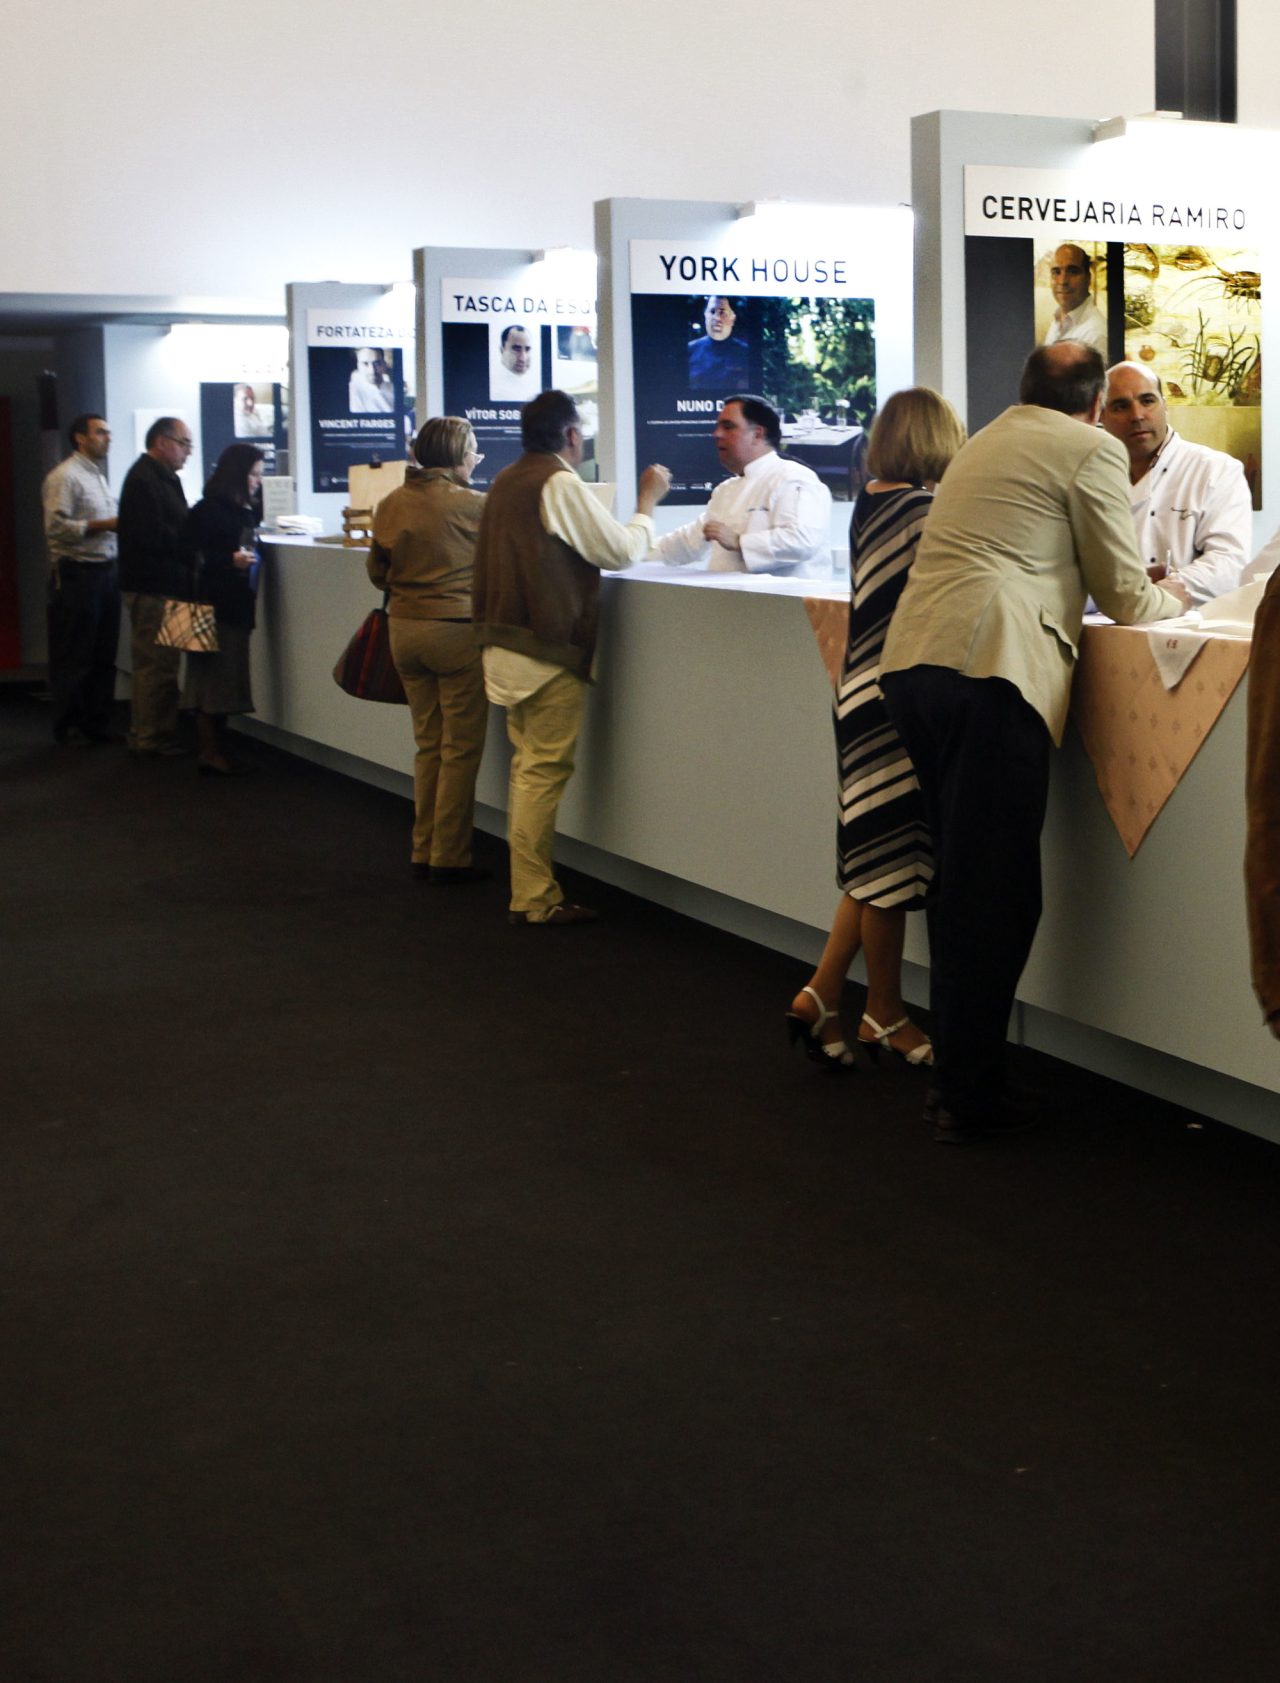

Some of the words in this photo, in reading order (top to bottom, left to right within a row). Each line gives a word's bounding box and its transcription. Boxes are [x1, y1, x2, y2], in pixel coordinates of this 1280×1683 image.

[982, 195, 1142, 225] CERVEJARIA
[1152, 204, 1246, 230] RAMIRO
[659, 255, 740, 282] YORK
[752, 258, 847, 284] HOUSE
[453, 295, 516, 313] TASCA
[523, 297, 548, 313] DA
[556, 298, 597, 314] ESQ
[464, 406, 498, 420] VÍTOR
[498, 408, 522, 421] SOB
[677, 400, 714, 412] NUNO
[716, 400, 725, 412] D
[318, 418, 359, 428] VINCENT
[360, 418, 396, 429] FARGES
